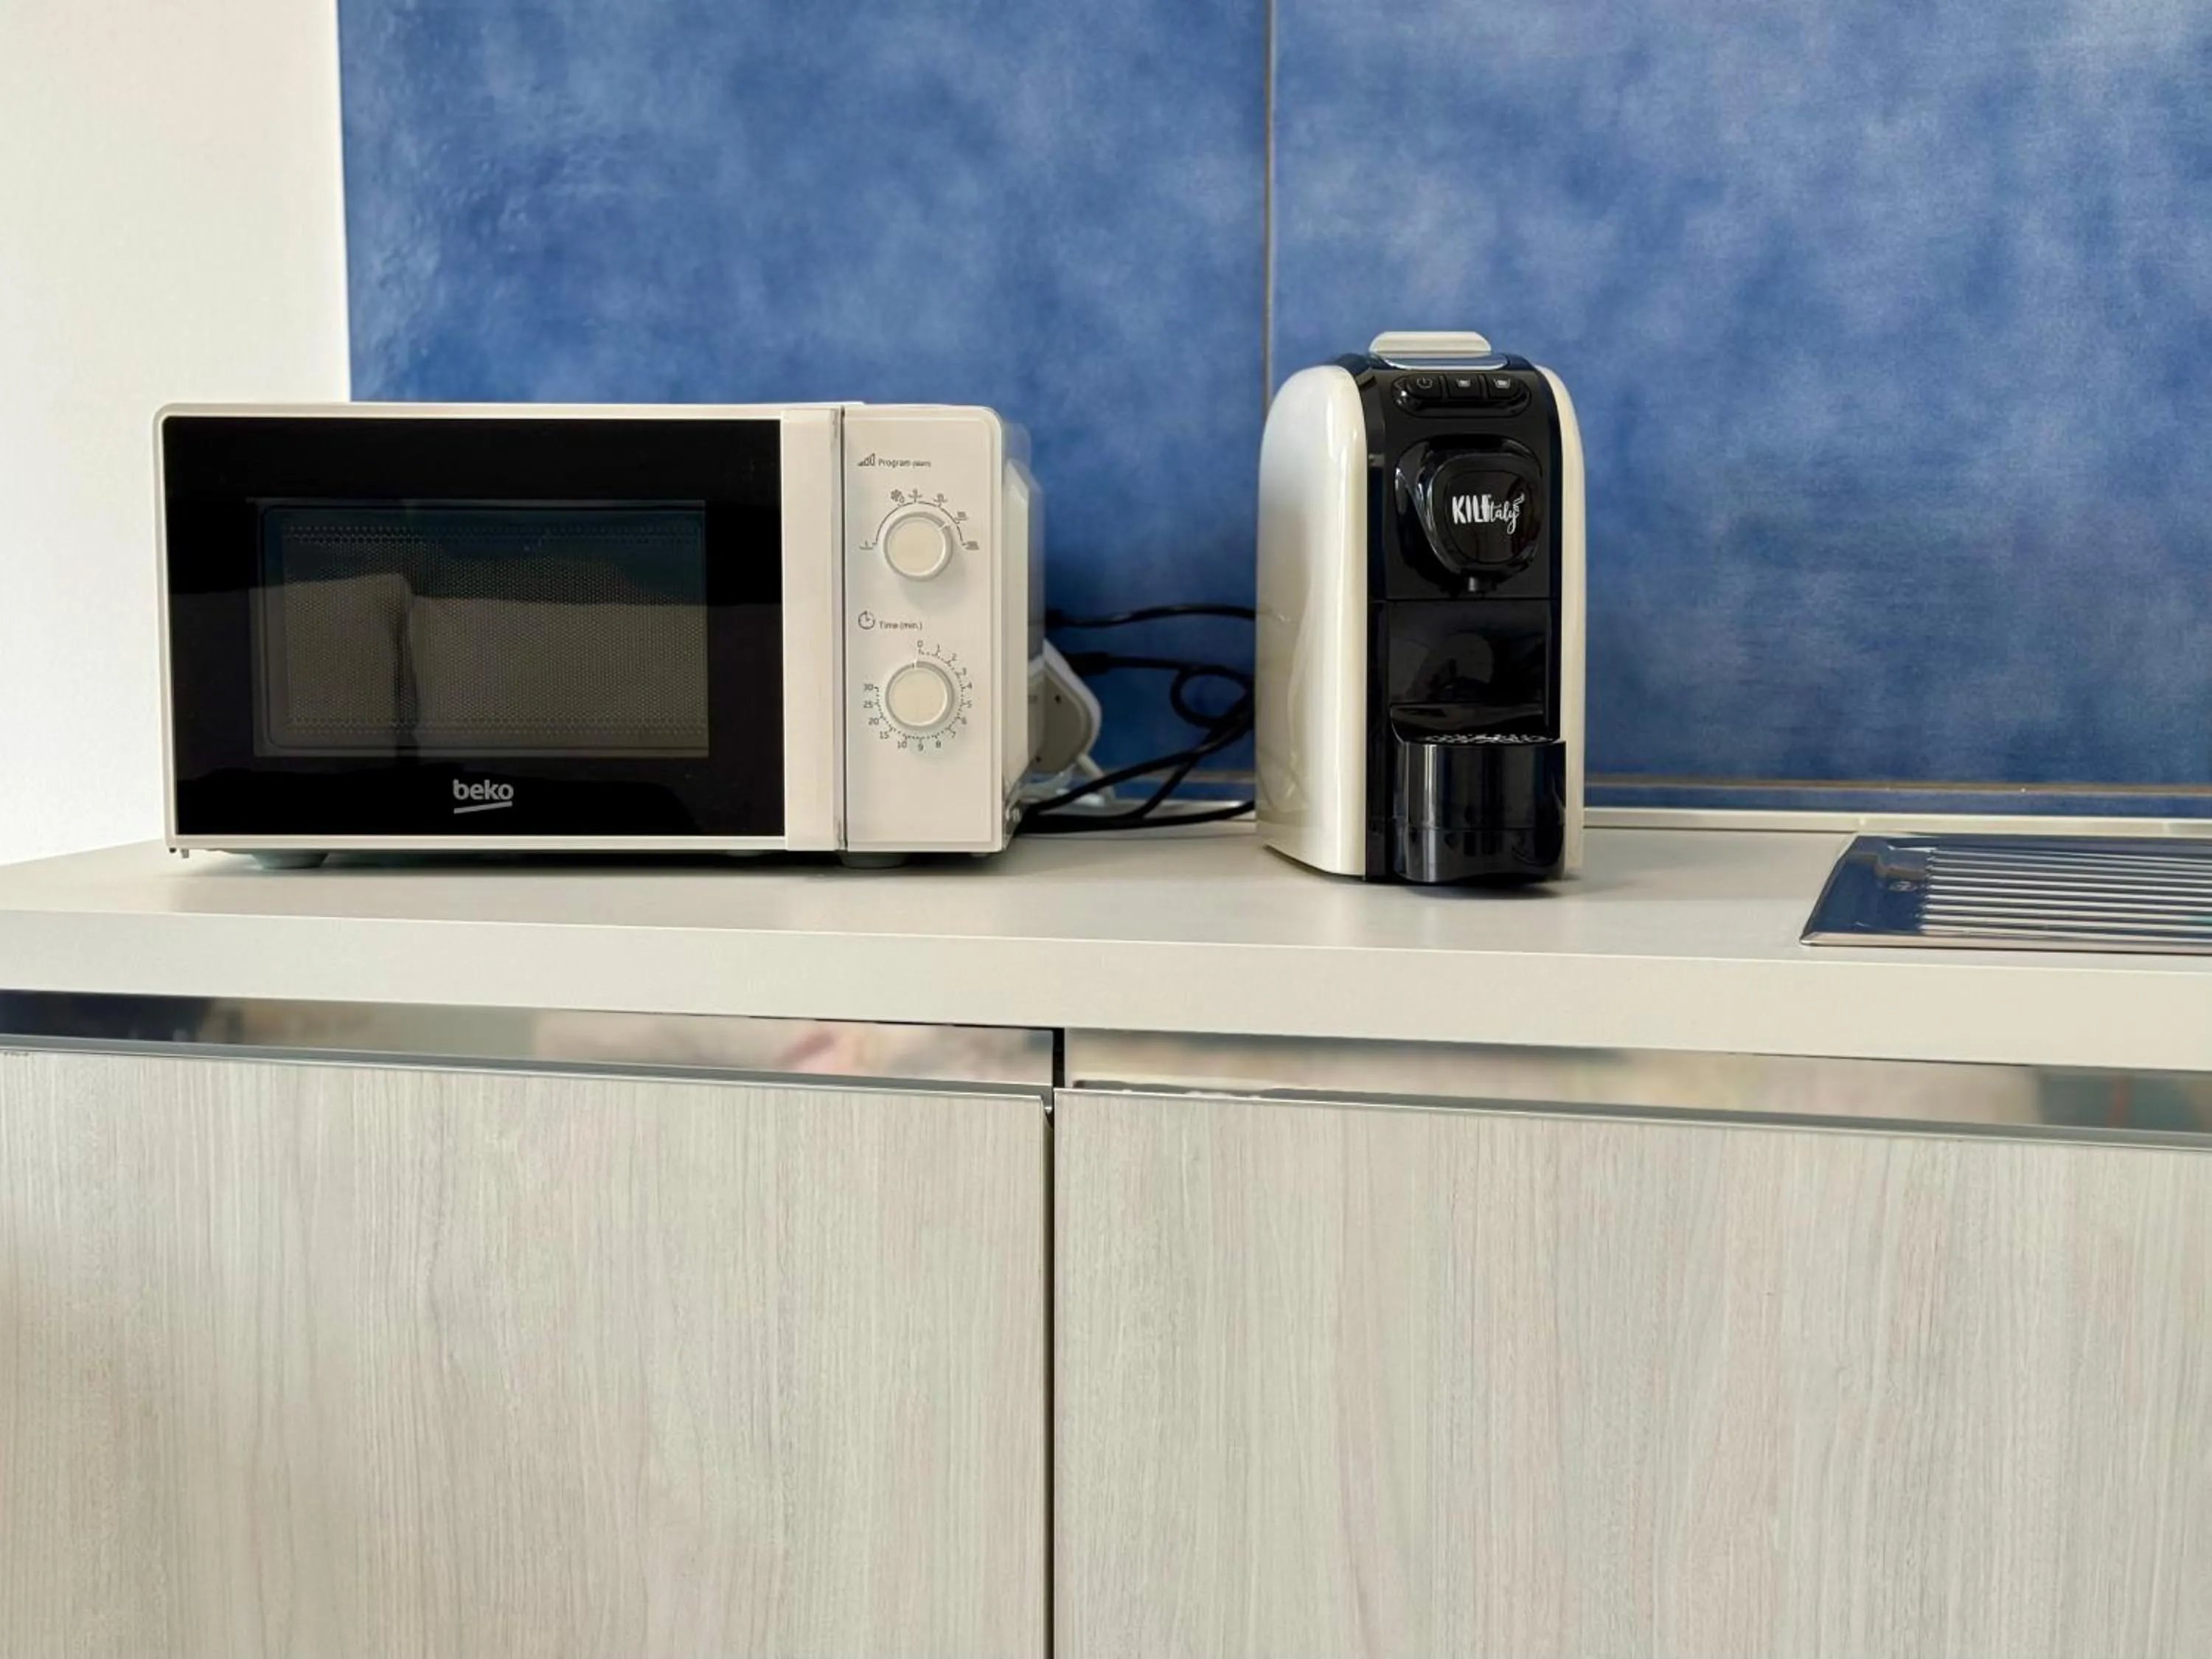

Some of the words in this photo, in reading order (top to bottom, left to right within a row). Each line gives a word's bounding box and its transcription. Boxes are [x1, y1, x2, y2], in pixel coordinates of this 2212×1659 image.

[878, 458, 911, 468] Program
[880, 621, 899, 630] Time
[917, 640, 923, 648] 0
[863, 700, 874, 709] 25
[879, 731, 889, 740] 15
[897, 740, 908, 748] 10
[453, 779, 515, 800] beko
